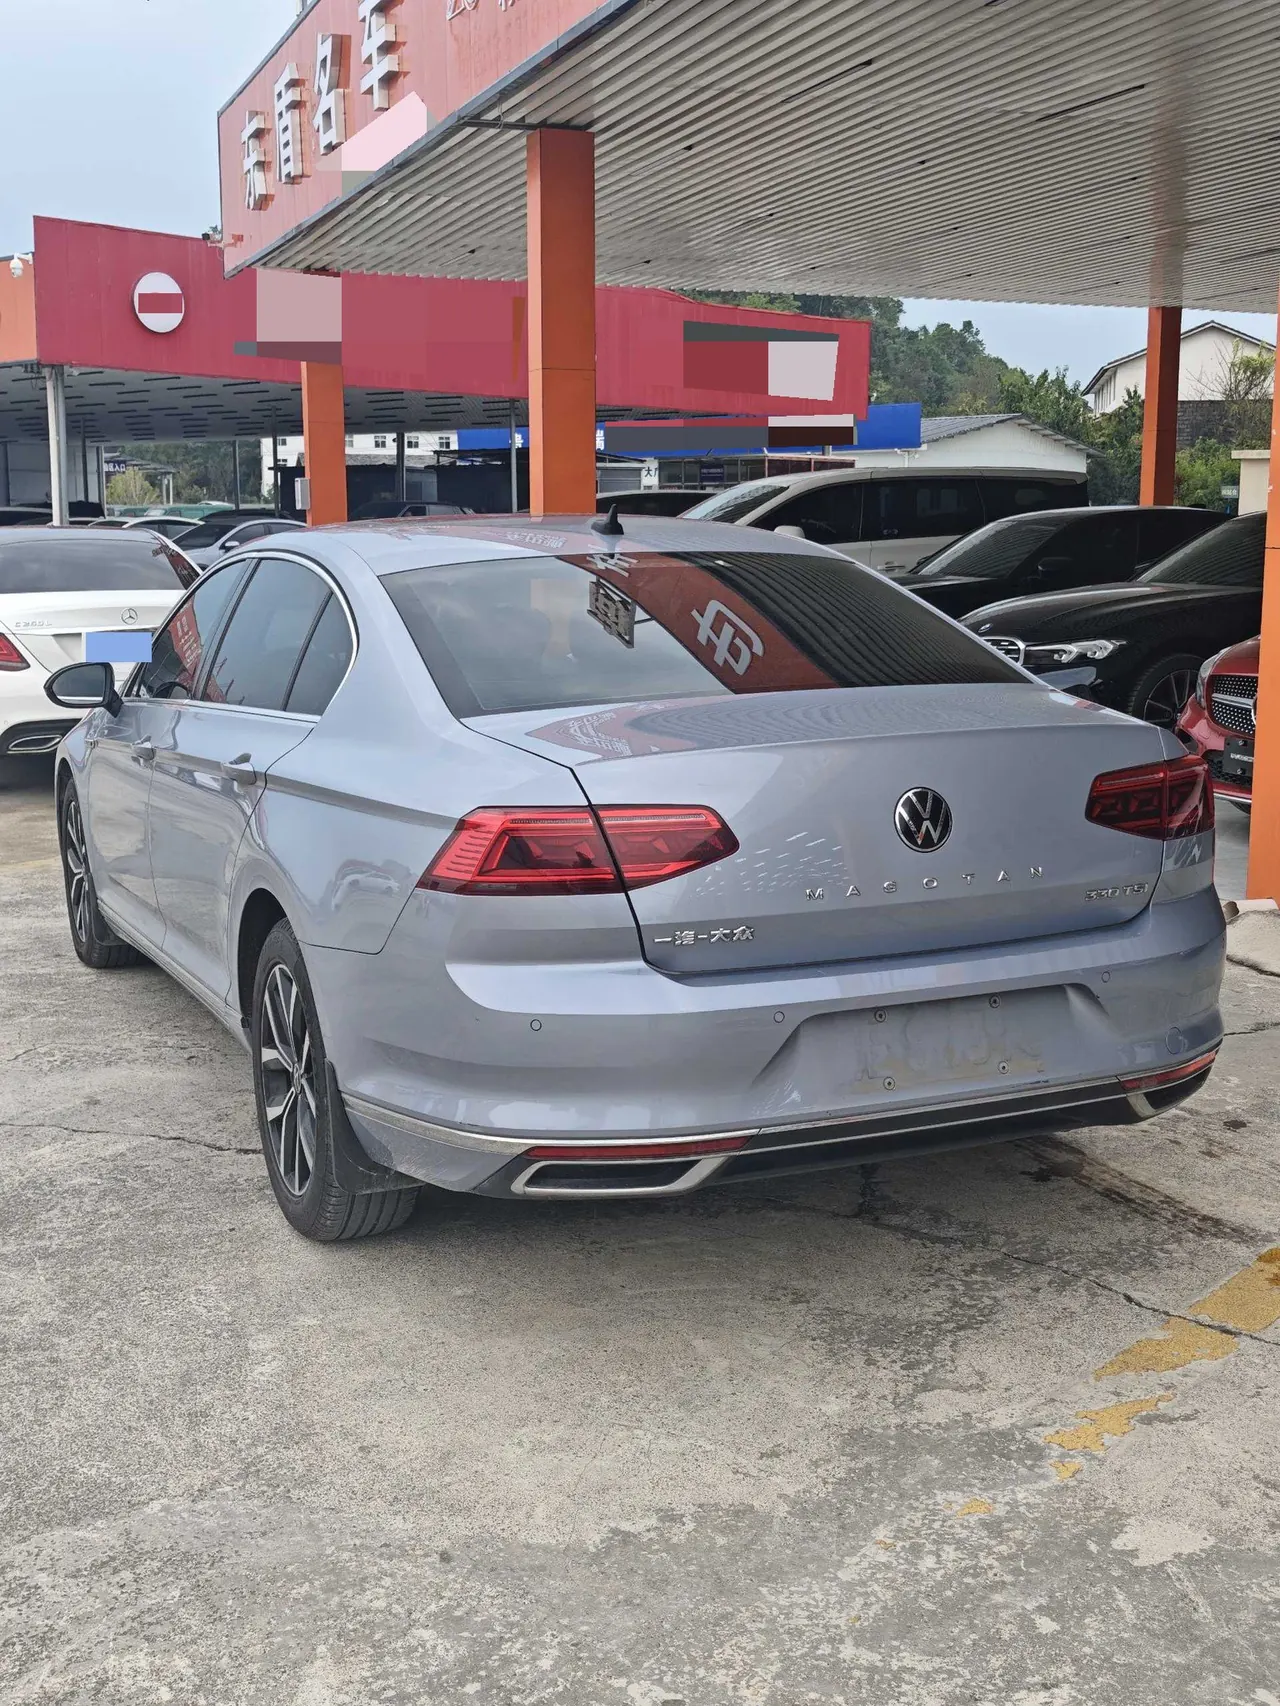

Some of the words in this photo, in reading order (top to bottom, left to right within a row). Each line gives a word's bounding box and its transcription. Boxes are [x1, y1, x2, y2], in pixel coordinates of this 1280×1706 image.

[805, 866, 1043, 900] MAGOTAN
[1085, 888, 1120, 901] 330
[1123, 883, 1149, 896] TSI
[654, 925, 754, 946] 一汽-大众
